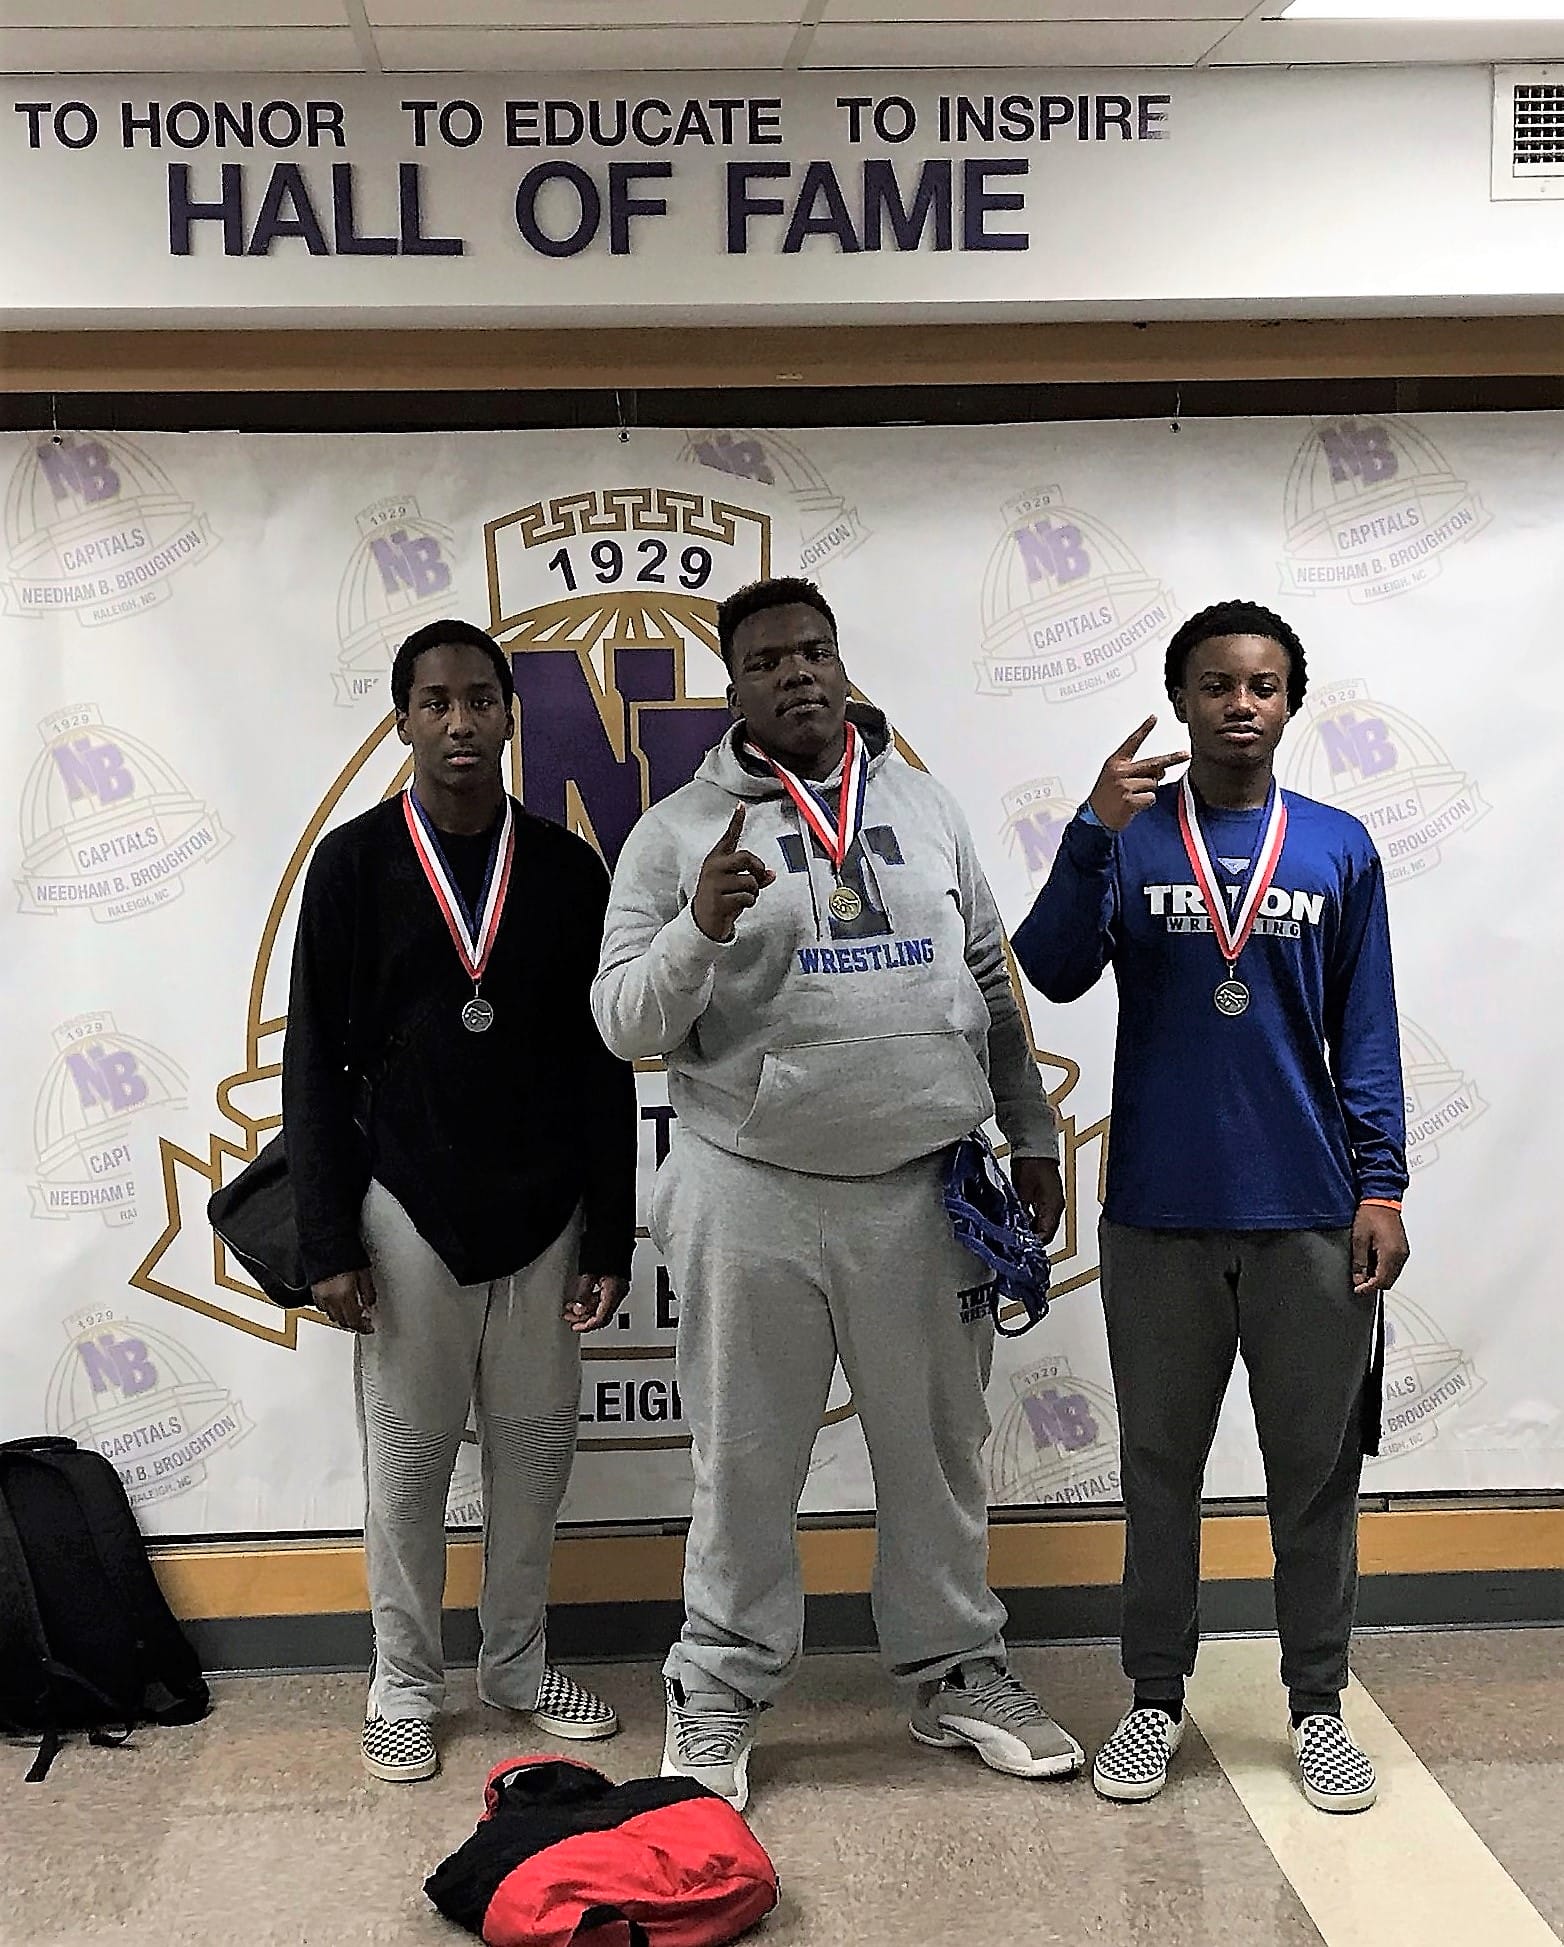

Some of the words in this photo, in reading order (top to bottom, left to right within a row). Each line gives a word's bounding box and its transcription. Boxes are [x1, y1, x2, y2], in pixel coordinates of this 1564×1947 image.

[15, 101, 98, 148] TO
[121, 101, 346, 148] HONOR
[401, 100, 484, 147] TO
[507, 98, 782, 147] EDUCATE
[837, 97, 917, 144] TO
[939, 95, 1170, 142] INSPIRE
[168, 162, 463, 255] HALL
[515, 160, 672, 257] OF
[726, 159, 1029, 253] FAME
[37, 438, 121, 504] NB
[1318, 420, 1398, 487] NB
[370, 506, 406, 526] 1929
[1015, 495, 1051, 515] 1929
[1337, 507, 1420, 550] CAPITALS
[22, 583, 101, 604] NEEDHAM
[101, 579, 114, 595] B.
[116, 530, 201, 590] BROUGHTON
[64, 528, 145, 570] CAPITALS
[370, 529, 452, 600] NB
[548, 538, 713, 592] 1929
[1014, 520, 1090, 584] NB
[1297, 563, 1369, 582] NEEDHAM
[1372, 559, 1387, 574] B.
[1389, 509, 1473, 568] BROUGHTON
[1412, 569, 1427, 582] NC
[994, 662, 1063, 682] NEEDHAM
[1066, 657, 1081, 673] B.
[1083, 606, 1167, 667] BROUGHTON
[1033, 606, 1112, 649] CAPITALS
[1107, 667, 1121, 680] NC
[1320, 689, 1356, 708] 1929
[53, 713, 90, 734] 1929
[1318, 711, 1399, 777] NB
[52, 737, 135, 806] NB
[78, 827, 158, 869] CAPITALS
[1388, 799, 1472, 858] BROUGHTON
[37, 880, 110, 901] NEEDHAM
[113, 877, 129, 892] B.
[131, 827, 213, 888] BROUGHTON
[1412, 858, 1426, 872] NC
[155, 888, 169, 901] NC
[1143, 885, 1325, 926] TRTON
[797, 938, 935, 975] WRESTLING
[67, 1022, 103, 1041] 1929
[66, 1045, 147, 1111] NB
[1409, 1154, 1423, 1168] NC
[50, 1184, 123, 1206] NEEDHAM
[77, 1310, 114, 1329] 1929
[76, 1334, 158, 1397] NB
[1022, 1389, 1099, 1452] NB
[1387, 1374, 1466, 1432] BROUGHTON
[101, 1416, 182, 1459] CAPITALS
[153, 1416, 236, 1476] BROUGHTON
